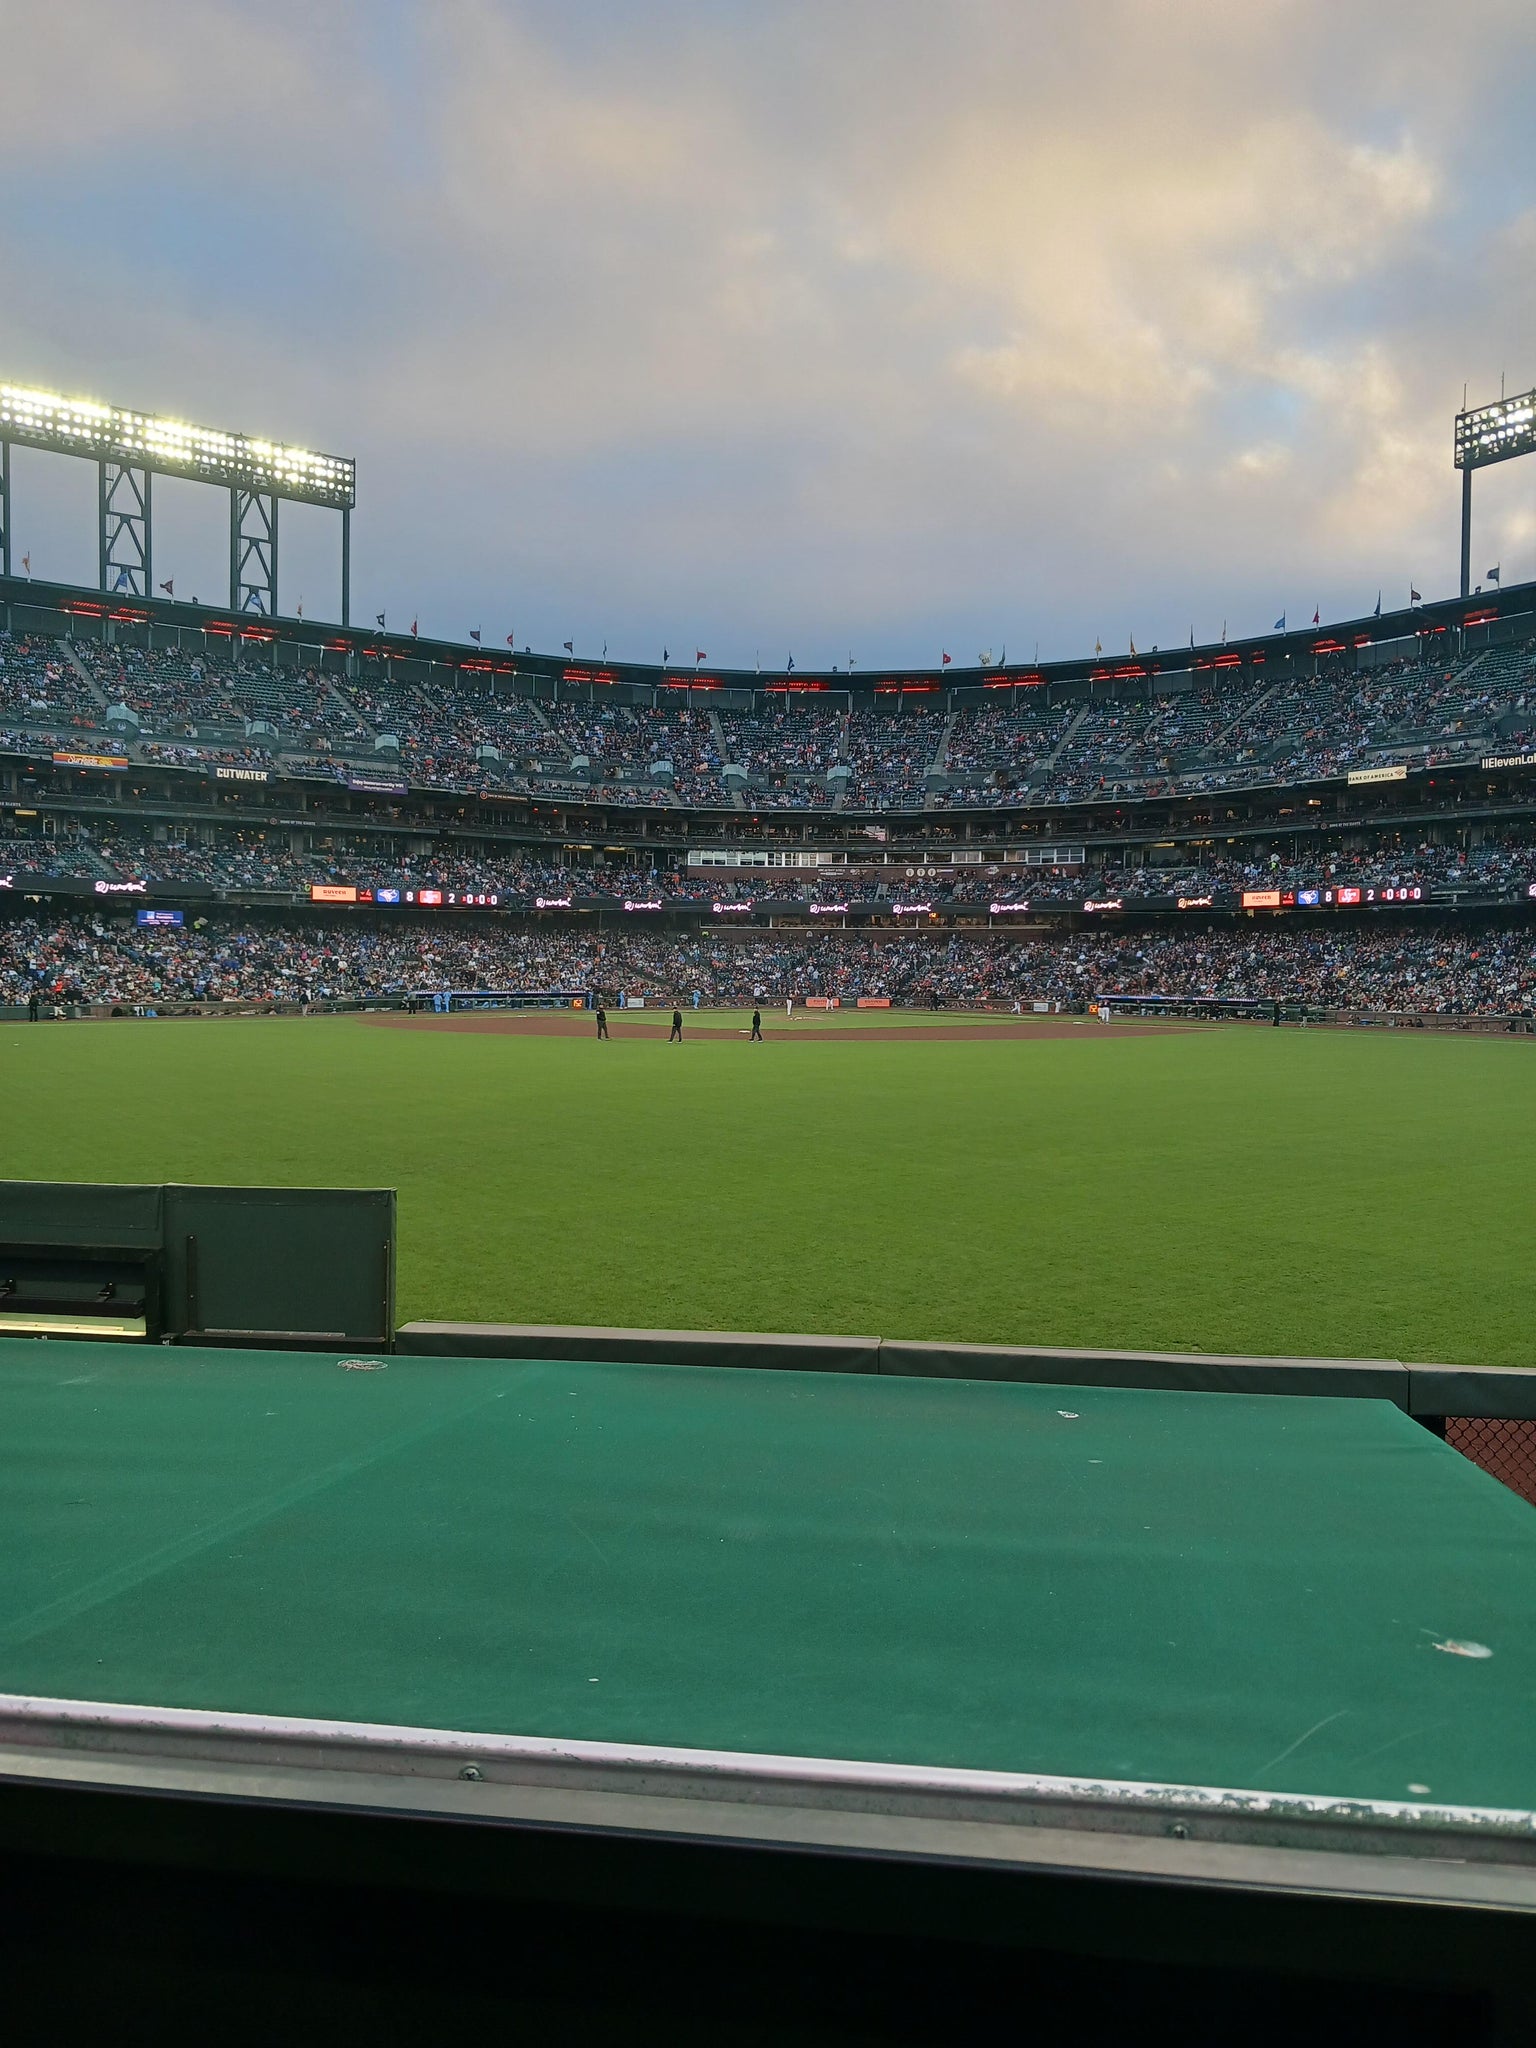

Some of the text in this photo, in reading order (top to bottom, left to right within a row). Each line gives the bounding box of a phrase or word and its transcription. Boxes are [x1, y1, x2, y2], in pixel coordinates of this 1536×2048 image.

[216, 767, 268, 781] CUTWATER
[406, 891, 414, 902] 8
[448, 893, 456, 903] 2
[467, 894, 474, 904] 0
[479, 895, 485, 905] 0
[491, 895, 498, 905] 0
[1287, 891, 1294, 899] 4
[1325, 891, 1332, 902] 8
[1367, 889, 1374, 900] 2
[1387, 889, 1394, 900] 0
[1400, 888, 1407, 899] 0
[1414, 887, 1421, 899] 0
